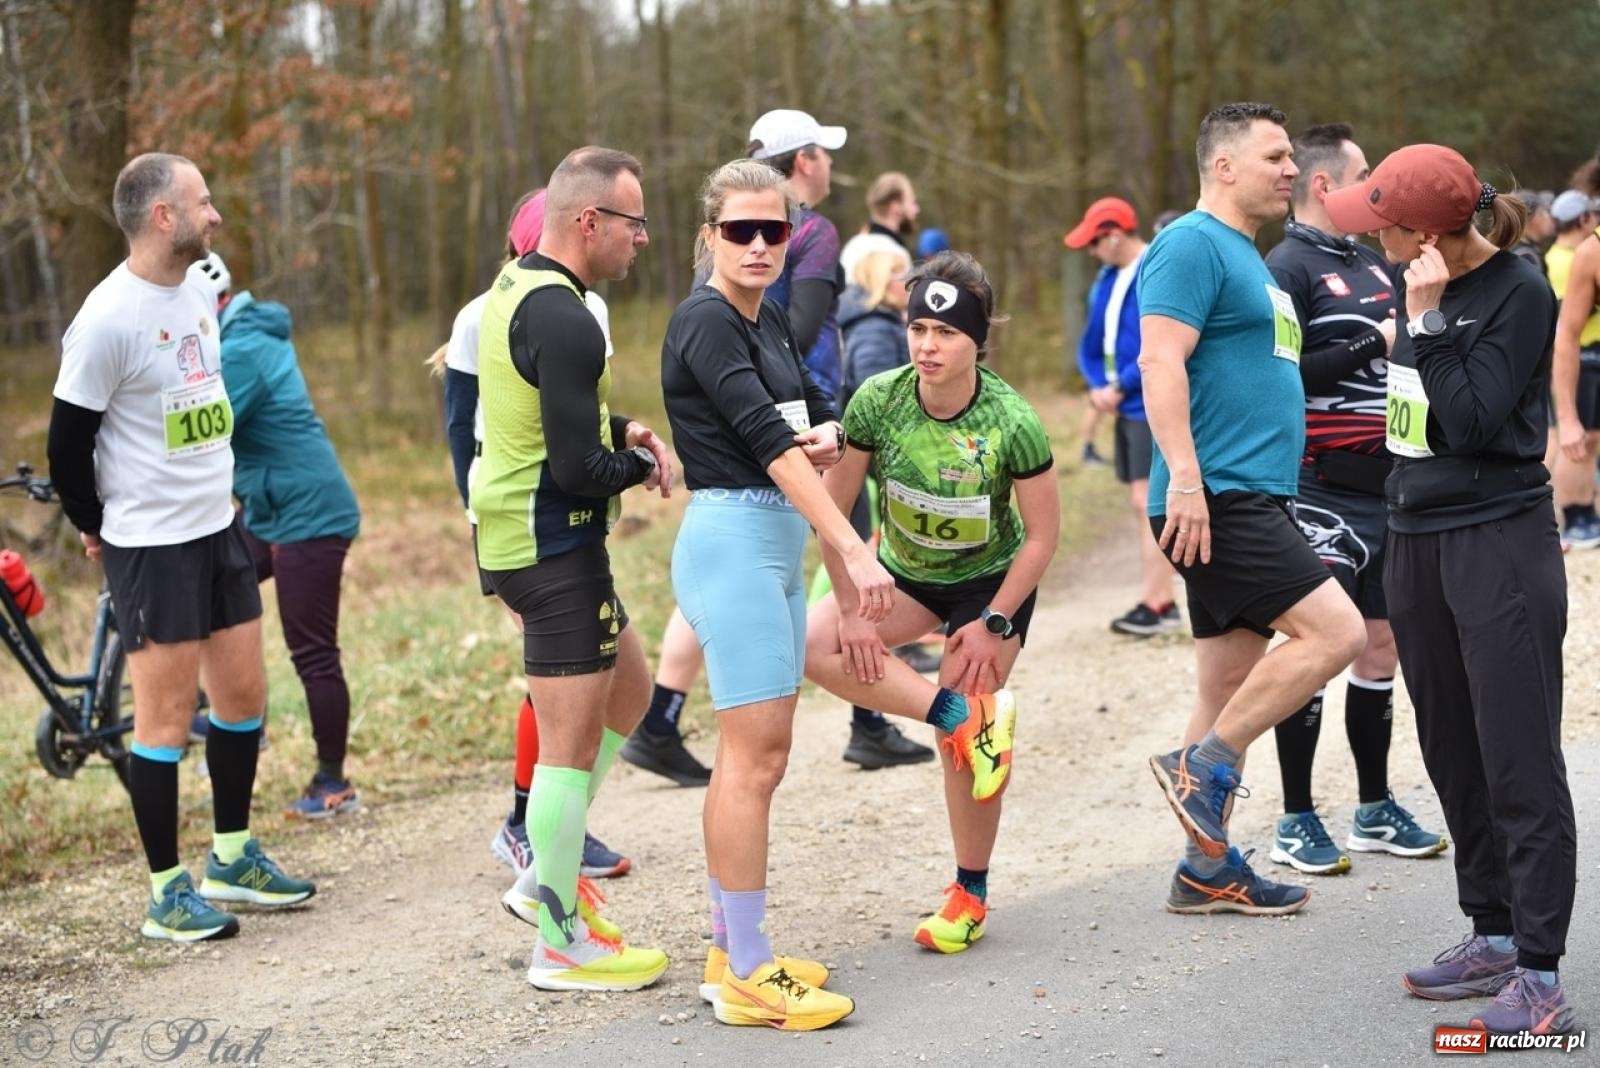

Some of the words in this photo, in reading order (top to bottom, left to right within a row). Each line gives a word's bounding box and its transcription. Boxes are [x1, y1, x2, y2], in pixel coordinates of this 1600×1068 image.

[179, 404, 226, 444] 103
[1389, 398, 1411, 439] 20
[692, 488, 730, 501] RO
[913, 513, 959, 540] 16
